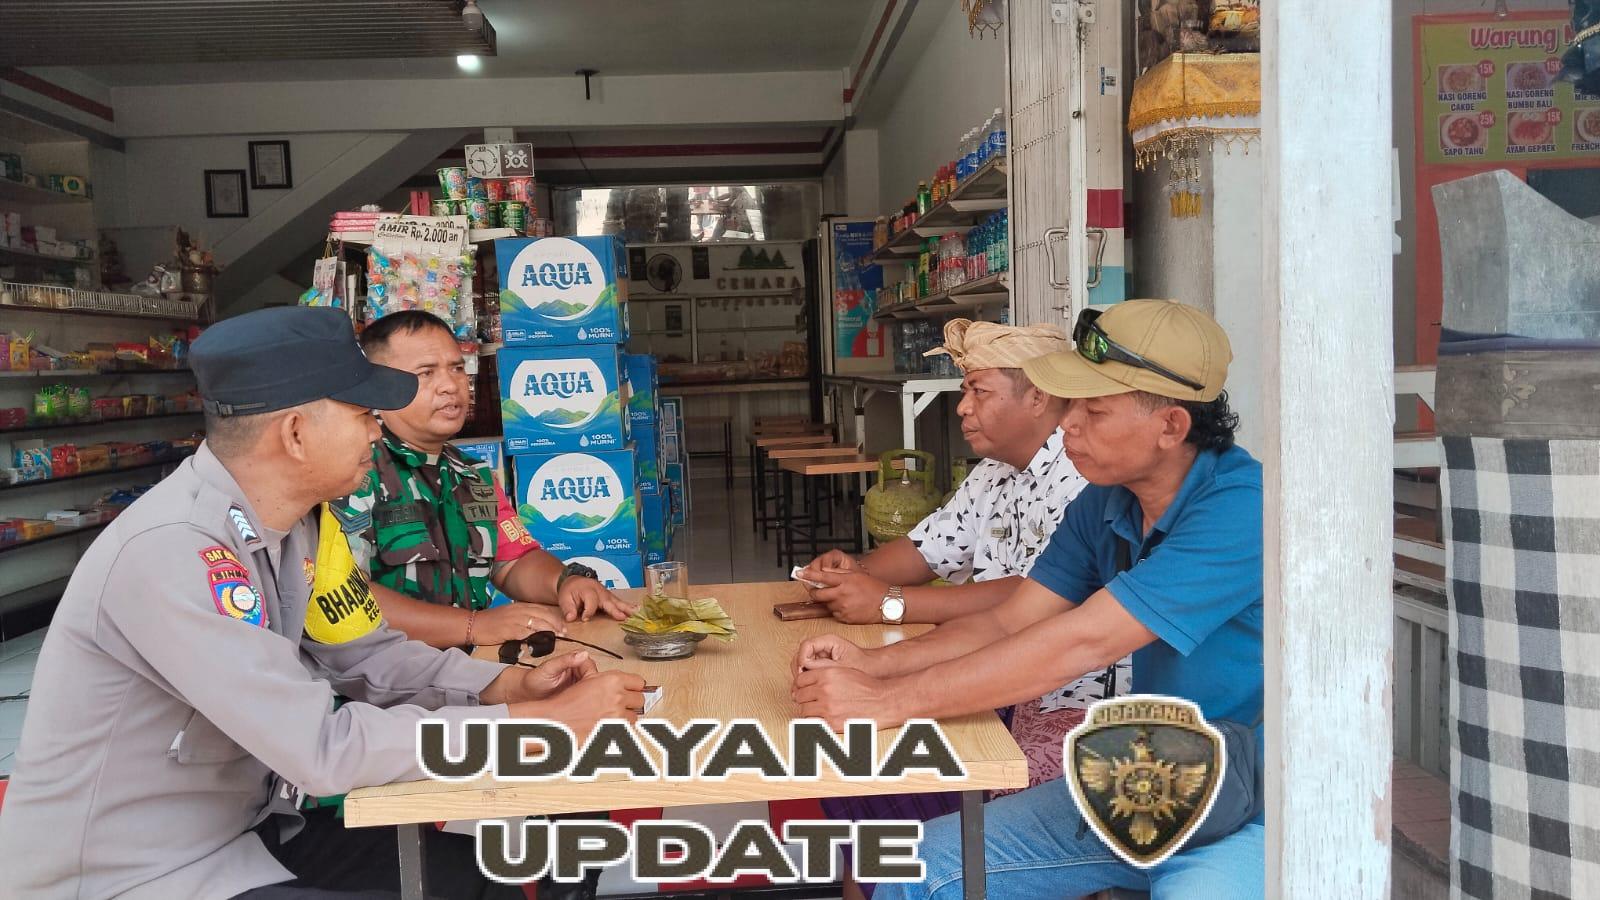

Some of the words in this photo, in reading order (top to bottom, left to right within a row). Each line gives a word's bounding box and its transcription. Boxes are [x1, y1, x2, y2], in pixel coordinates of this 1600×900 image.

[1471, 28, 1558, 52] Warung
[1479, 64, 1493, 74] 15K
[1439, 93, 1455, 101] NASI
[1457, 92, 1487, 100] GORENG
[1507, 90, 1522, 99] NASI
[1525, 89, 1554, 97] GORENG
[1508, 100, 1534, 109] BUMBU
[1536, 100, 1553, 108] BALI
[1444, 148, 1463, 156] SAPO
[1465, 147, 1484, 155] TAHU
[1506, 145, 1525, 153] AYAM
[1528, 144, 1556, 152] GEPREK
[379, 223, 409, 234] AMIR
[424, 228, 448, 243] 2.000
[449, 233, 458, 242] an
[521, 263, 593, 290] AQUA
[716, 276, 802, 290] CEMARA
[523, 371, 594, 398] AQUA
[540, 476, 611, 503] AQUA
[467, 504, 490, 518] TNI
